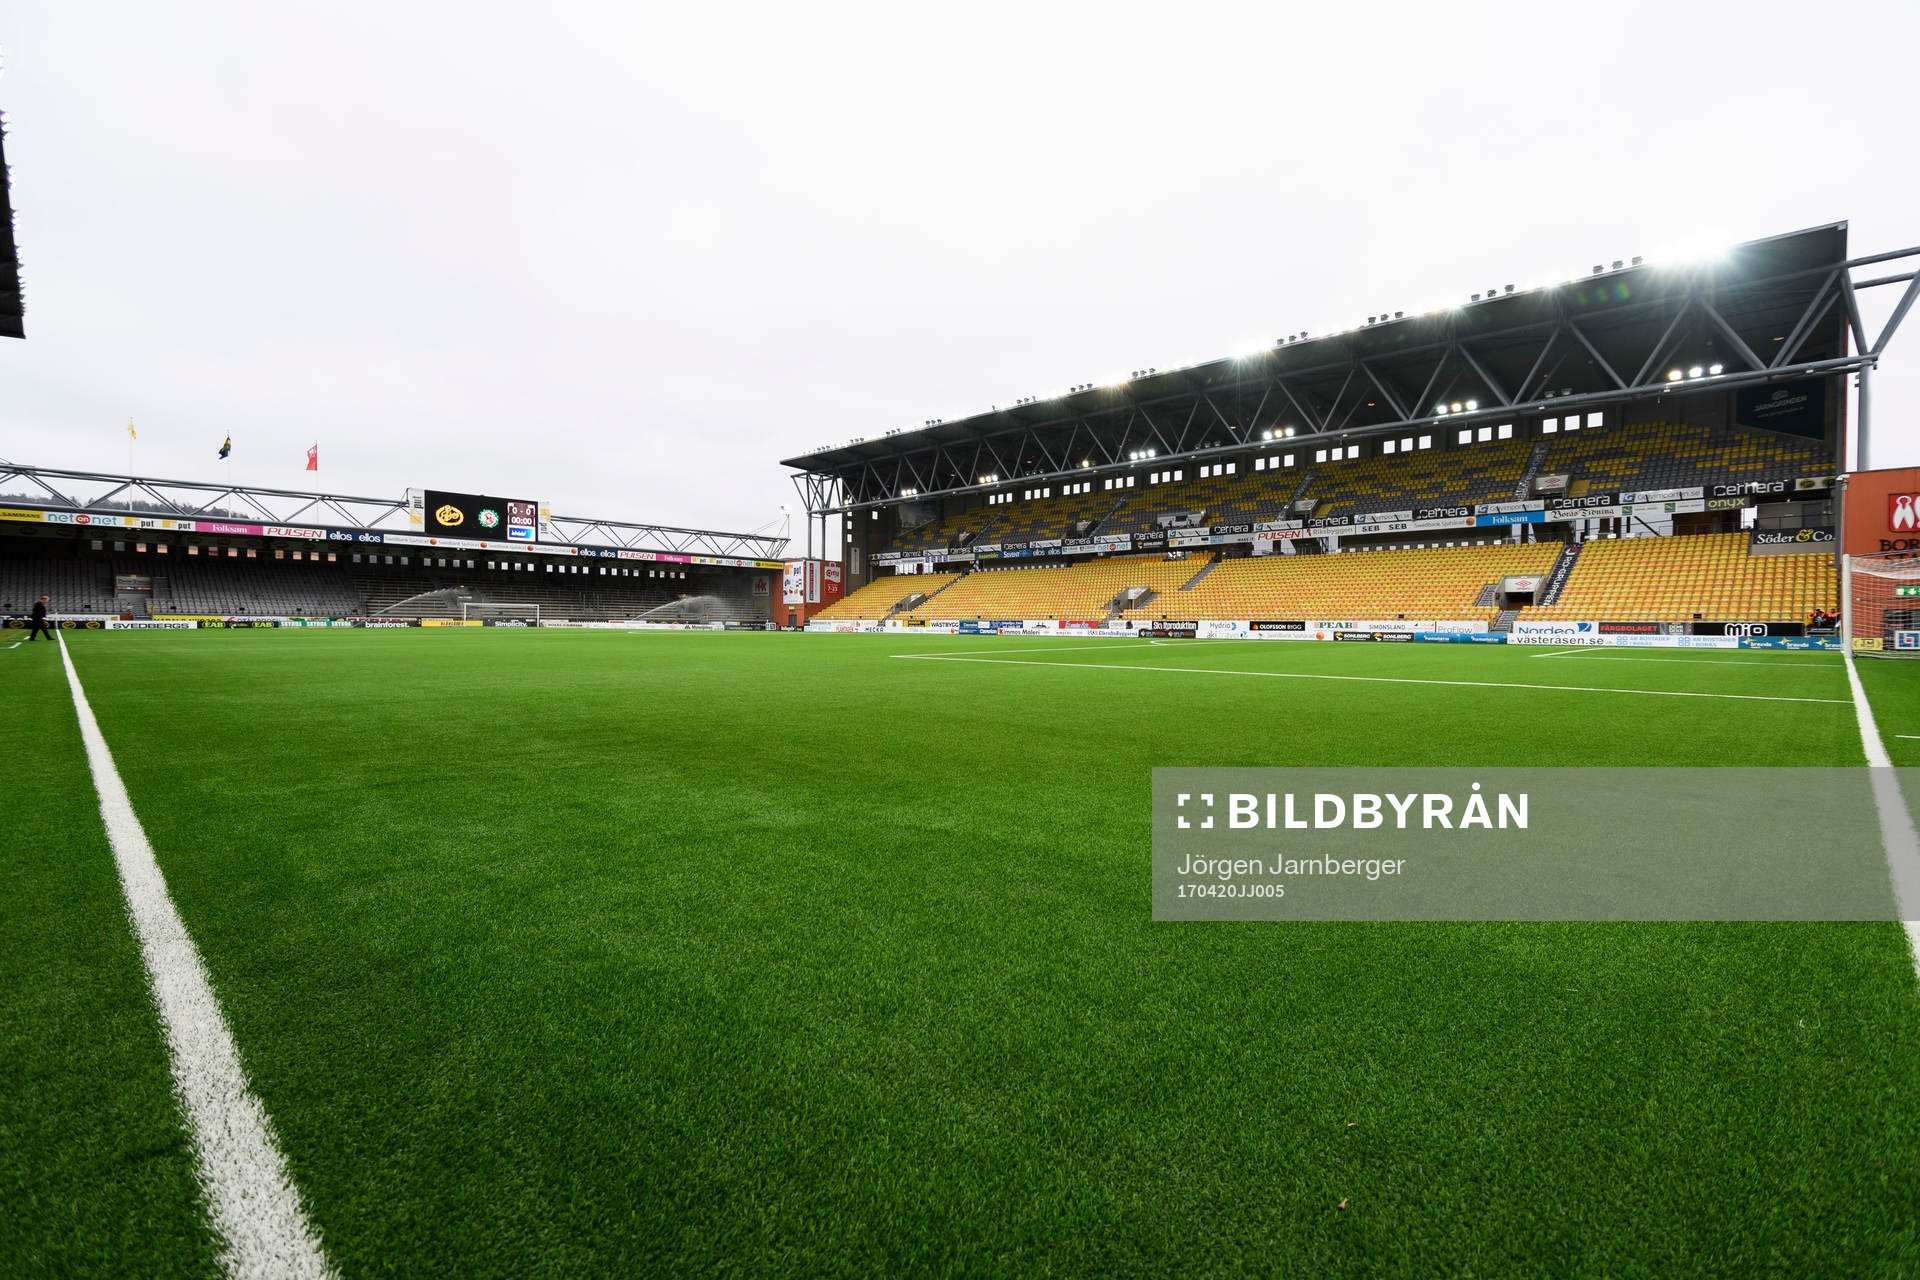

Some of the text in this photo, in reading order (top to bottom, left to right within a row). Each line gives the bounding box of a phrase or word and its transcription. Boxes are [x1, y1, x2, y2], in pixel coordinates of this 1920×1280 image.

[1708, 498, 1745, 510] onyx
[140, 519, 154, 528] put
[510, 516, 532, 525] 00:00
[1492, 516, 1528, 524] Folksam
[178, 522, 191, 530] put
[212, 524, 248, 534] Folksam
[267, 527, 324, 538] PULSEN
[330, 531, 352, 541] ellos
[1258, 530, 1301, 541] PULSEN
[1756, 529, 1836, 544] Söder & Co.
[358, 532, 380, 543] ellos
[619, 551, 654, 560] PULSEN
[365, 621, 410, 629] brainforest.
[494, 621, 528, 629] Simplicity.
[1438, 625, 1472, 634] ProFlow
[1600, 624, 1658, 632] FÄRGBOLAGET
[1518, 626, 1574, 634] Nordea
